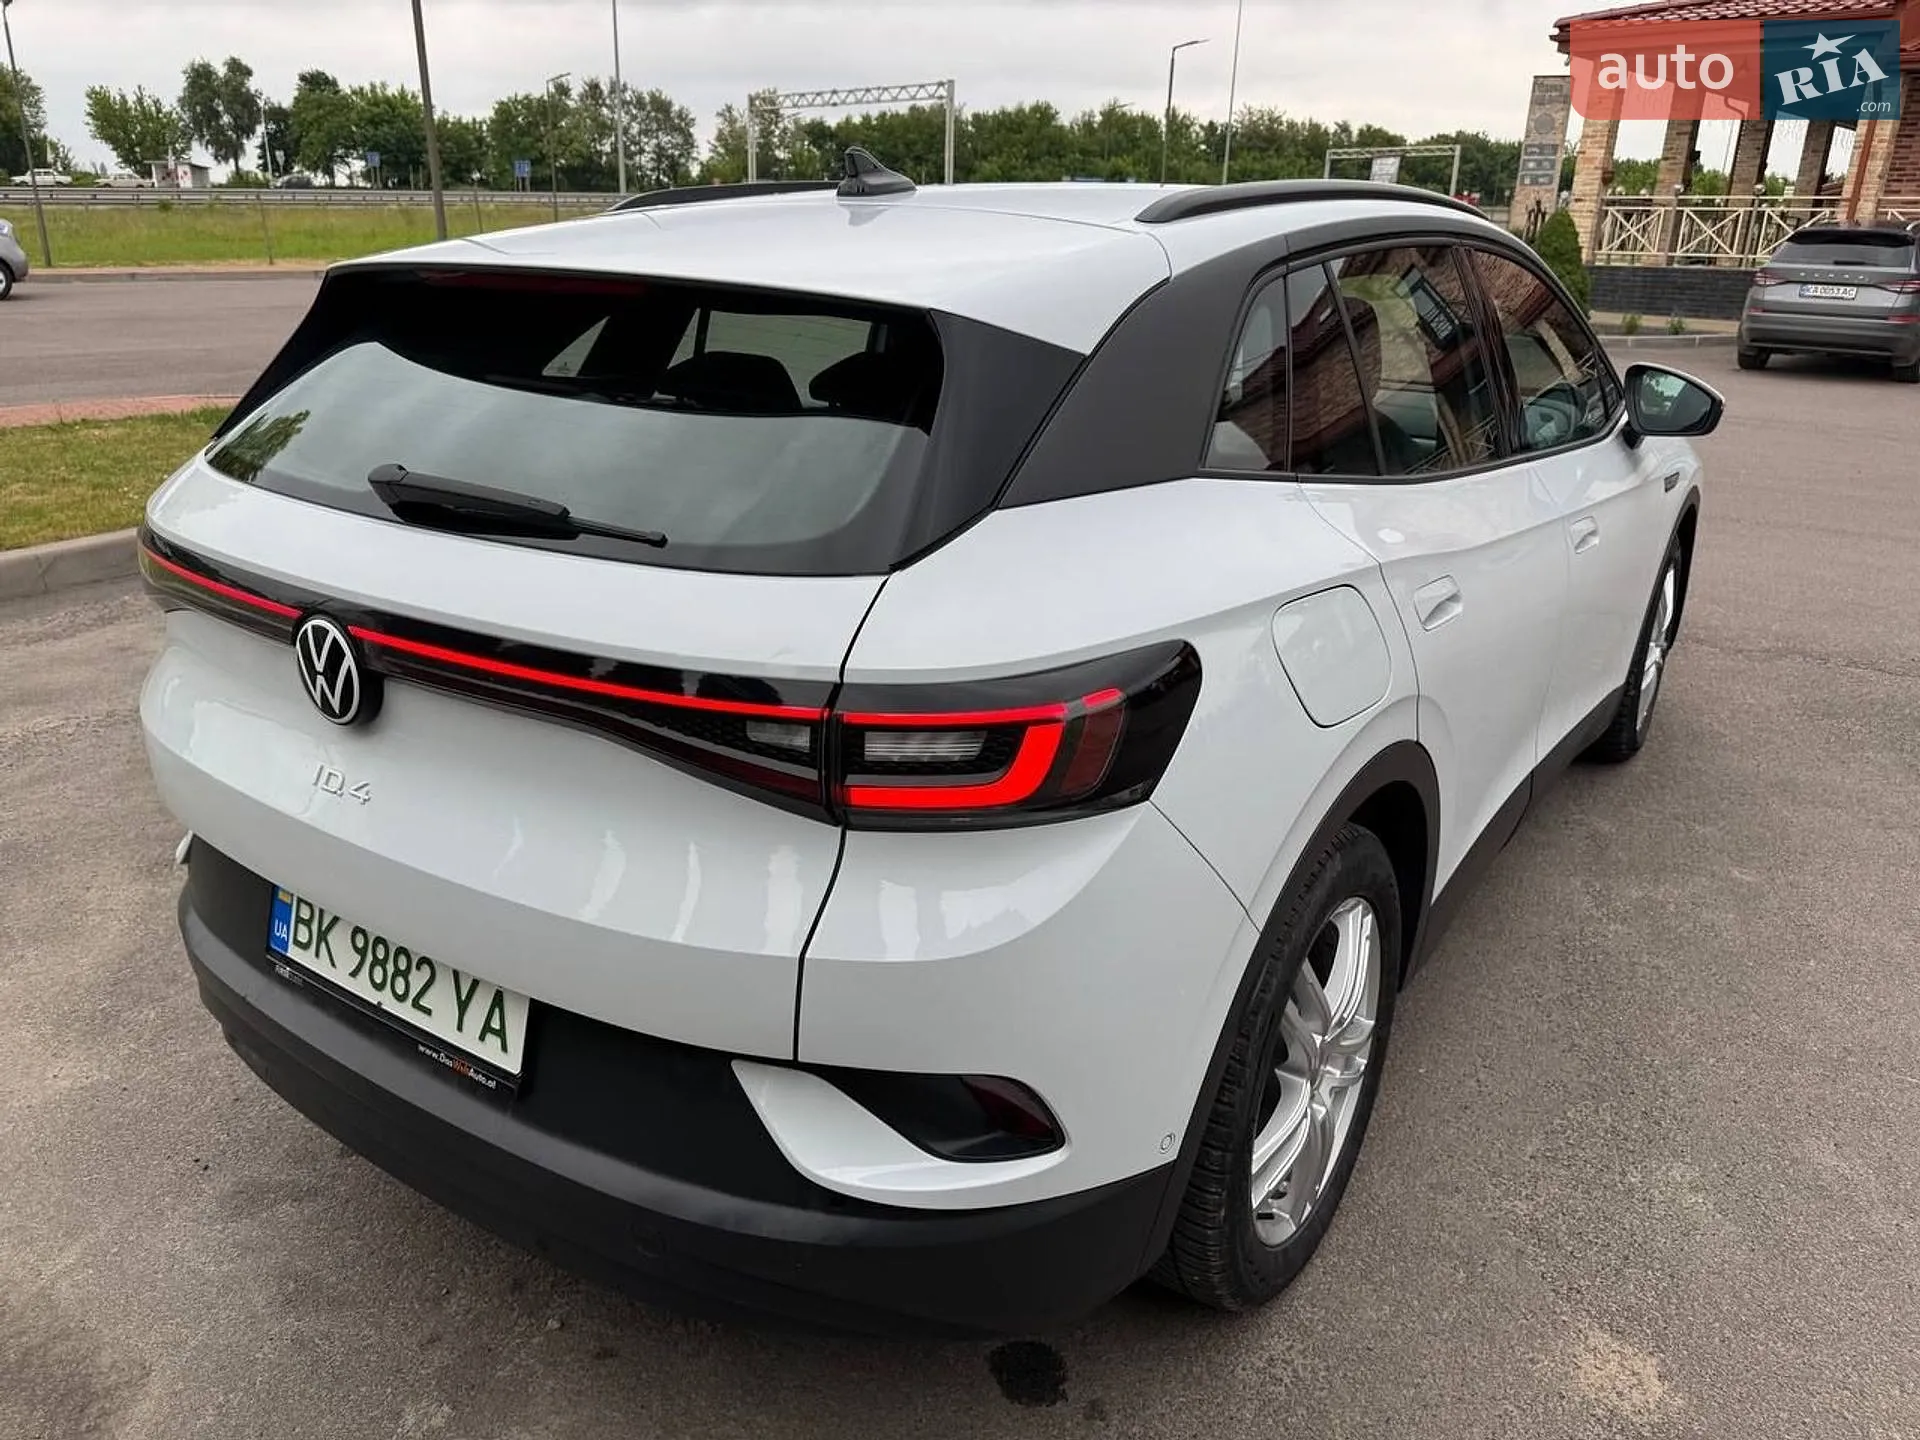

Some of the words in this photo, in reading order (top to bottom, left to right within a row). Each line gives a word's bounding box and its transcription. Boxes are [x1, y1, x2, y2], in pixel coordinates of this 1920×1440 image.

[274, 919, 288, 940] UA
[292, 896, 341, 969] BK
[348, 925, 437, 1016] 9882
[453, 969, 509, 1054] YA
